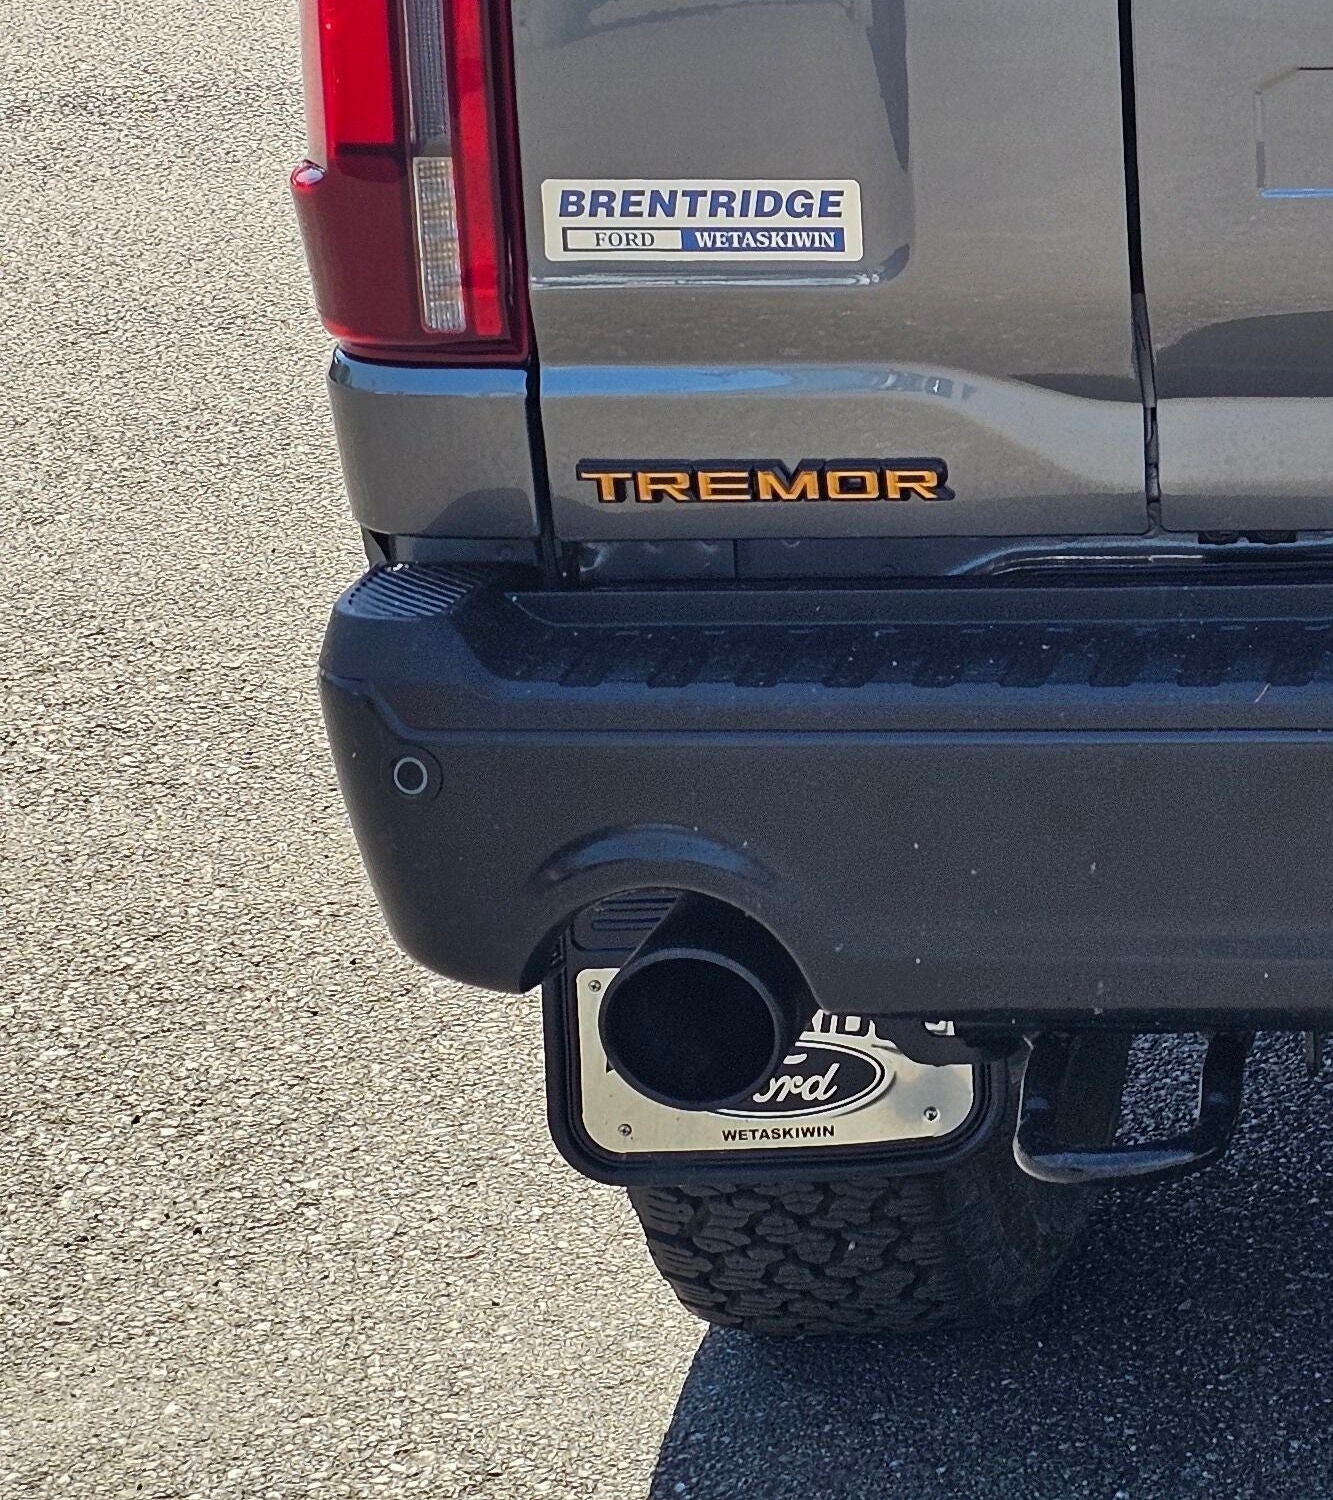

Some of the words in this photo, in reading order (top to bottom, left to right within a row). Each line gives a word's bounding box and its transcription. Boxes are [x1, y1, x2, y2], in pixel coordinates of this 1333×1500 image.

[559, 189, 845, 219] BRENTRIDGE
[594, 232, 655, 248] FORD
[695, 231, 836, 249] WETASKIWIN
[577, 460, 954, 502] TREMOR
[721, 1124, 835, 1142] WETASKIWIN
